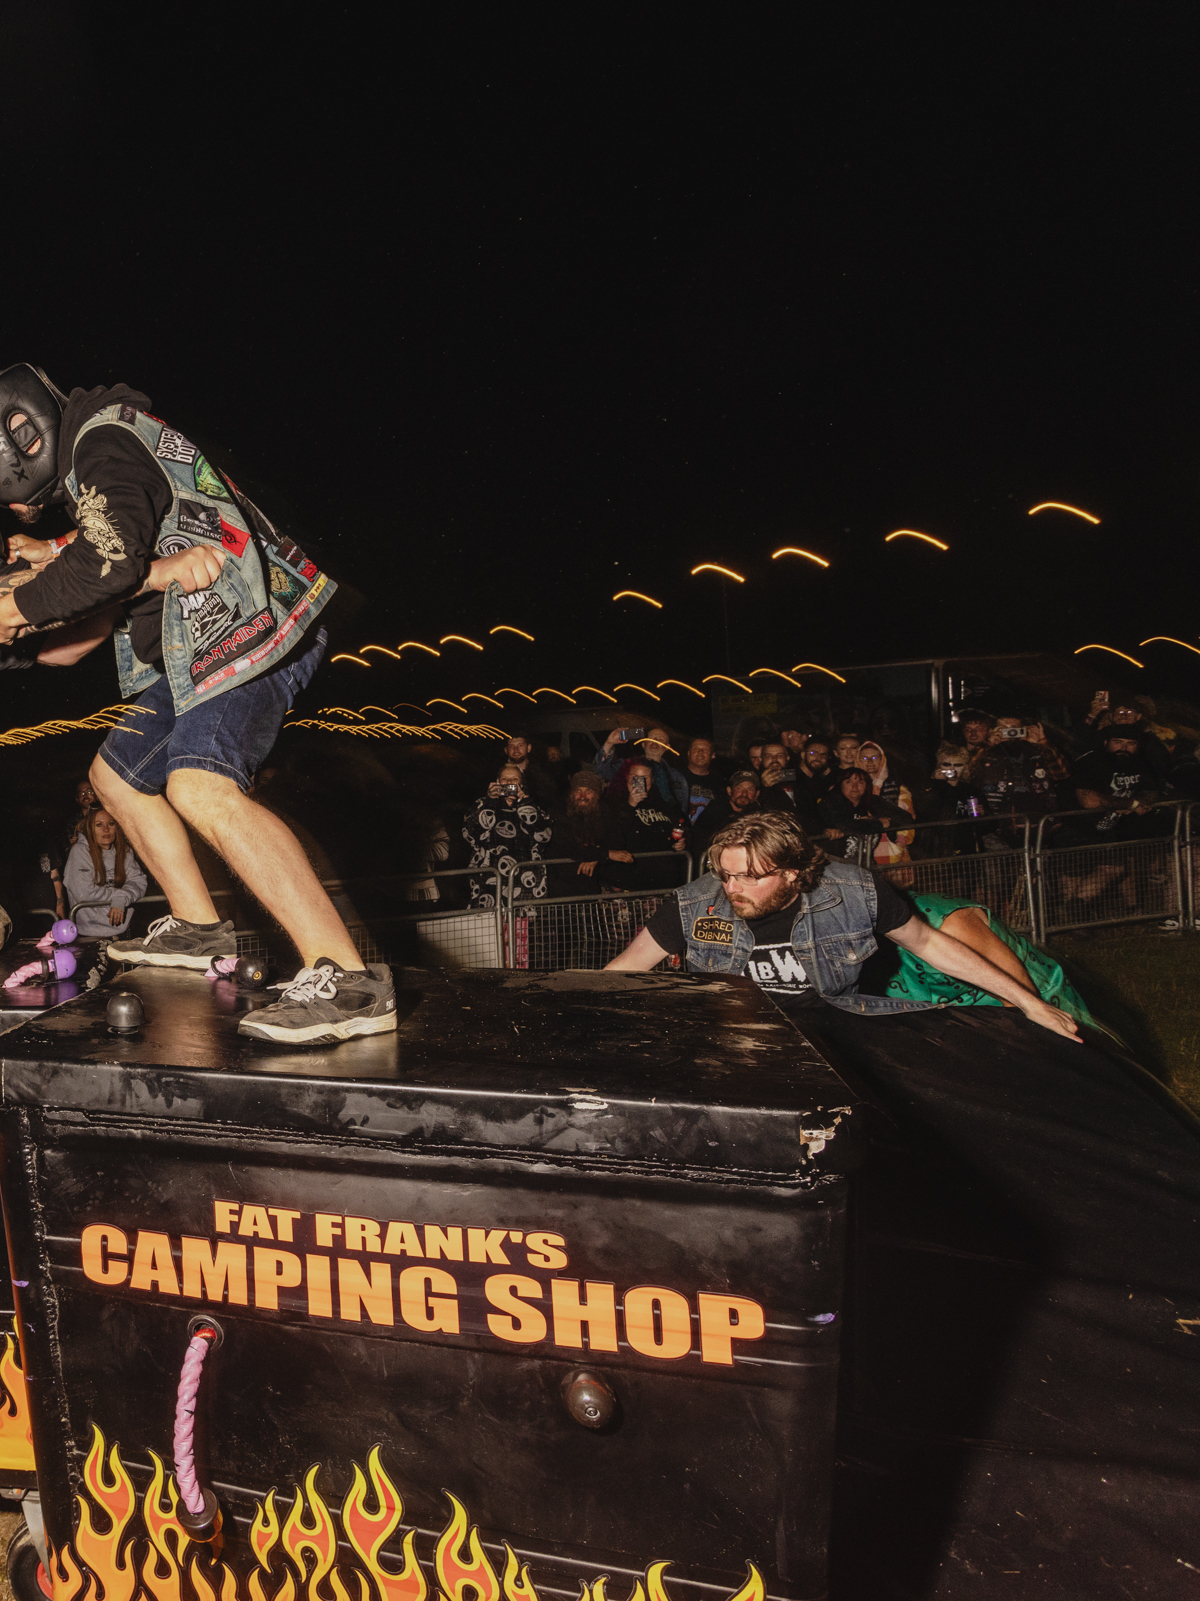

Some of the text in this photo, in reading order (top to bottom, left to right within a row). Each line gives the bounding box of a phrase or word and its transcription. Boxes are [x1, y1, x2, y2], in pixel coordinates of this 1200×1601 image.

[177, 435, 197, 464] DOW
[177, 590, 212, 619] PANT
[191, 611, 274, 676] IRON MAIDEN
[702, 921, 734, 932] SHRED
[214, 1201, 569, 1270] FAT FRANK'S
[81, 1224, 766, 1365] CAMPING SHOP
